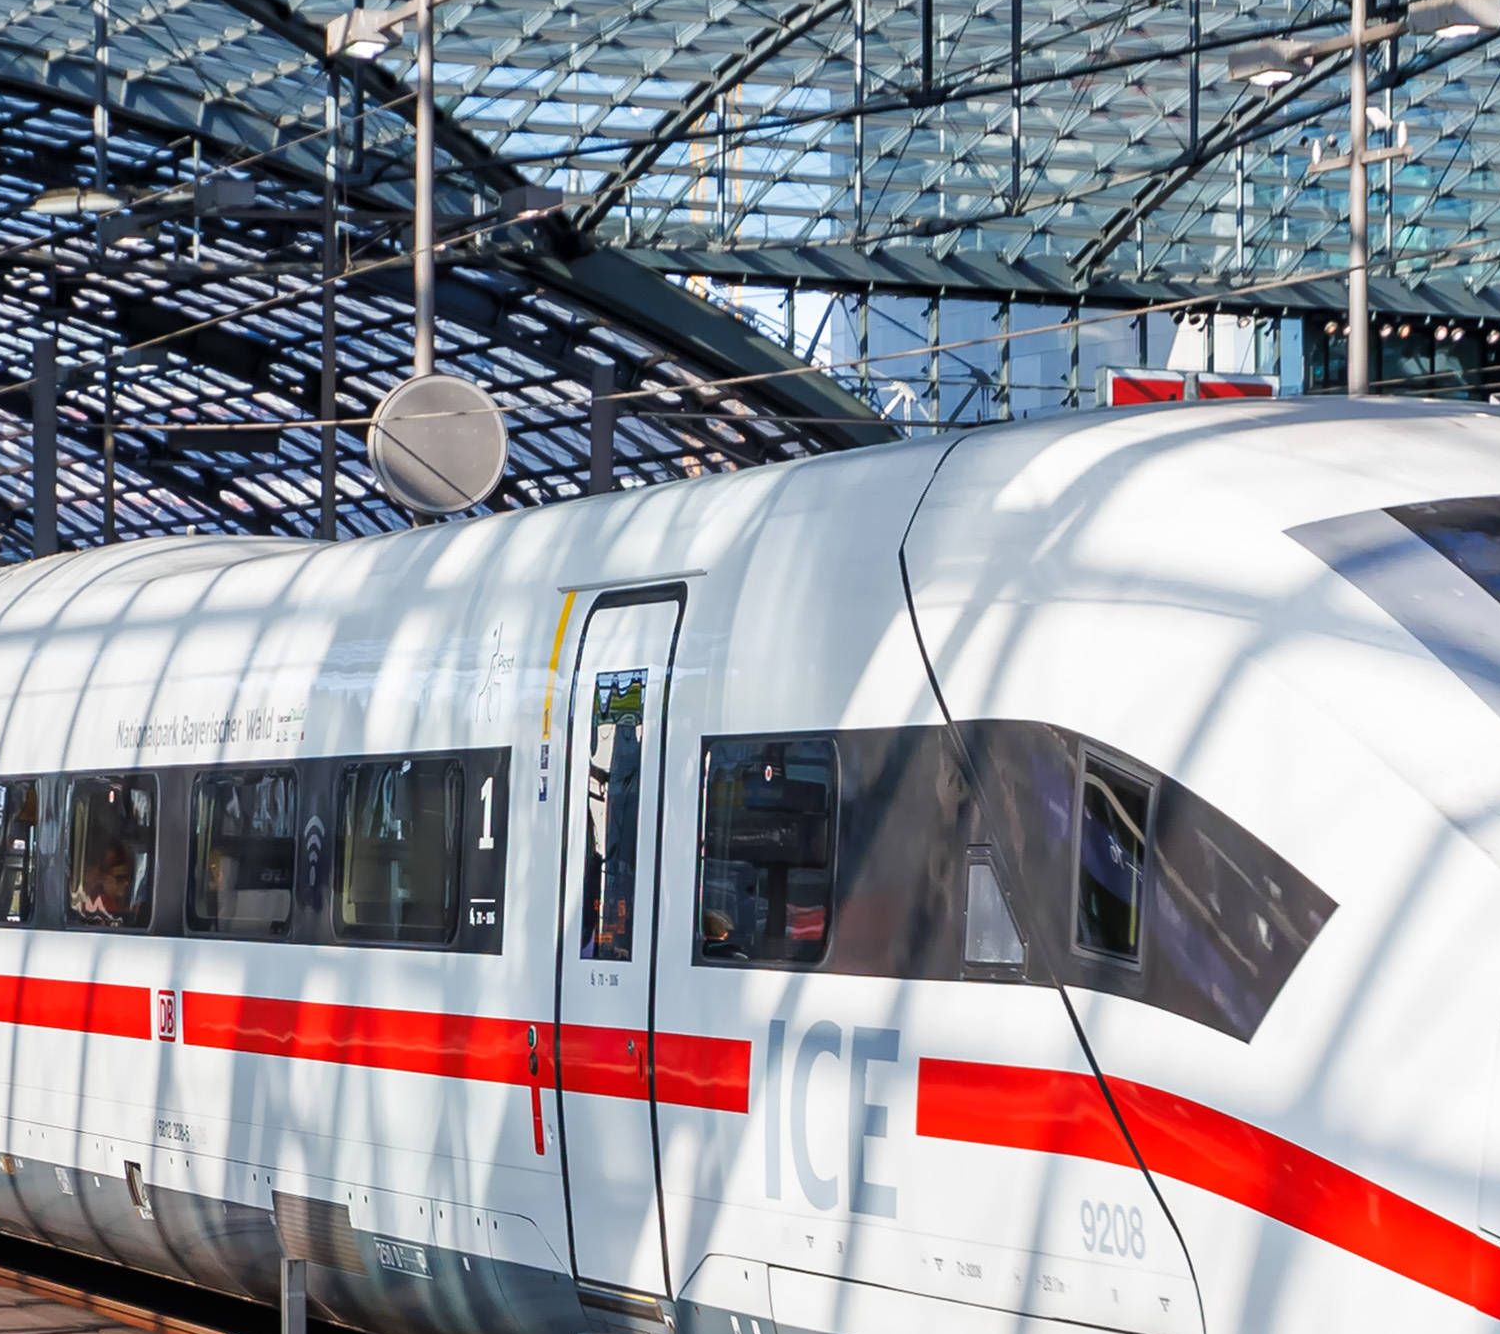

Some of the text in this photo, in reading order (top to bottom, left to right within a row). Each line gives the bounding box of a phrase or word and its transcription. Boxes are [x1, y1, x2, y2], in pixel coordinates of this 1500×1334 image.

[115, 717, 178, 755] Nationalpark
[180, 710, 243, 754] Bayerischer
[245, 706, 274, 743] Wald
[478, 776, 495, 850] 1
[764, 1018, 901, 1220] ICE
[1080, 1199, 1146, 1260] 9208
